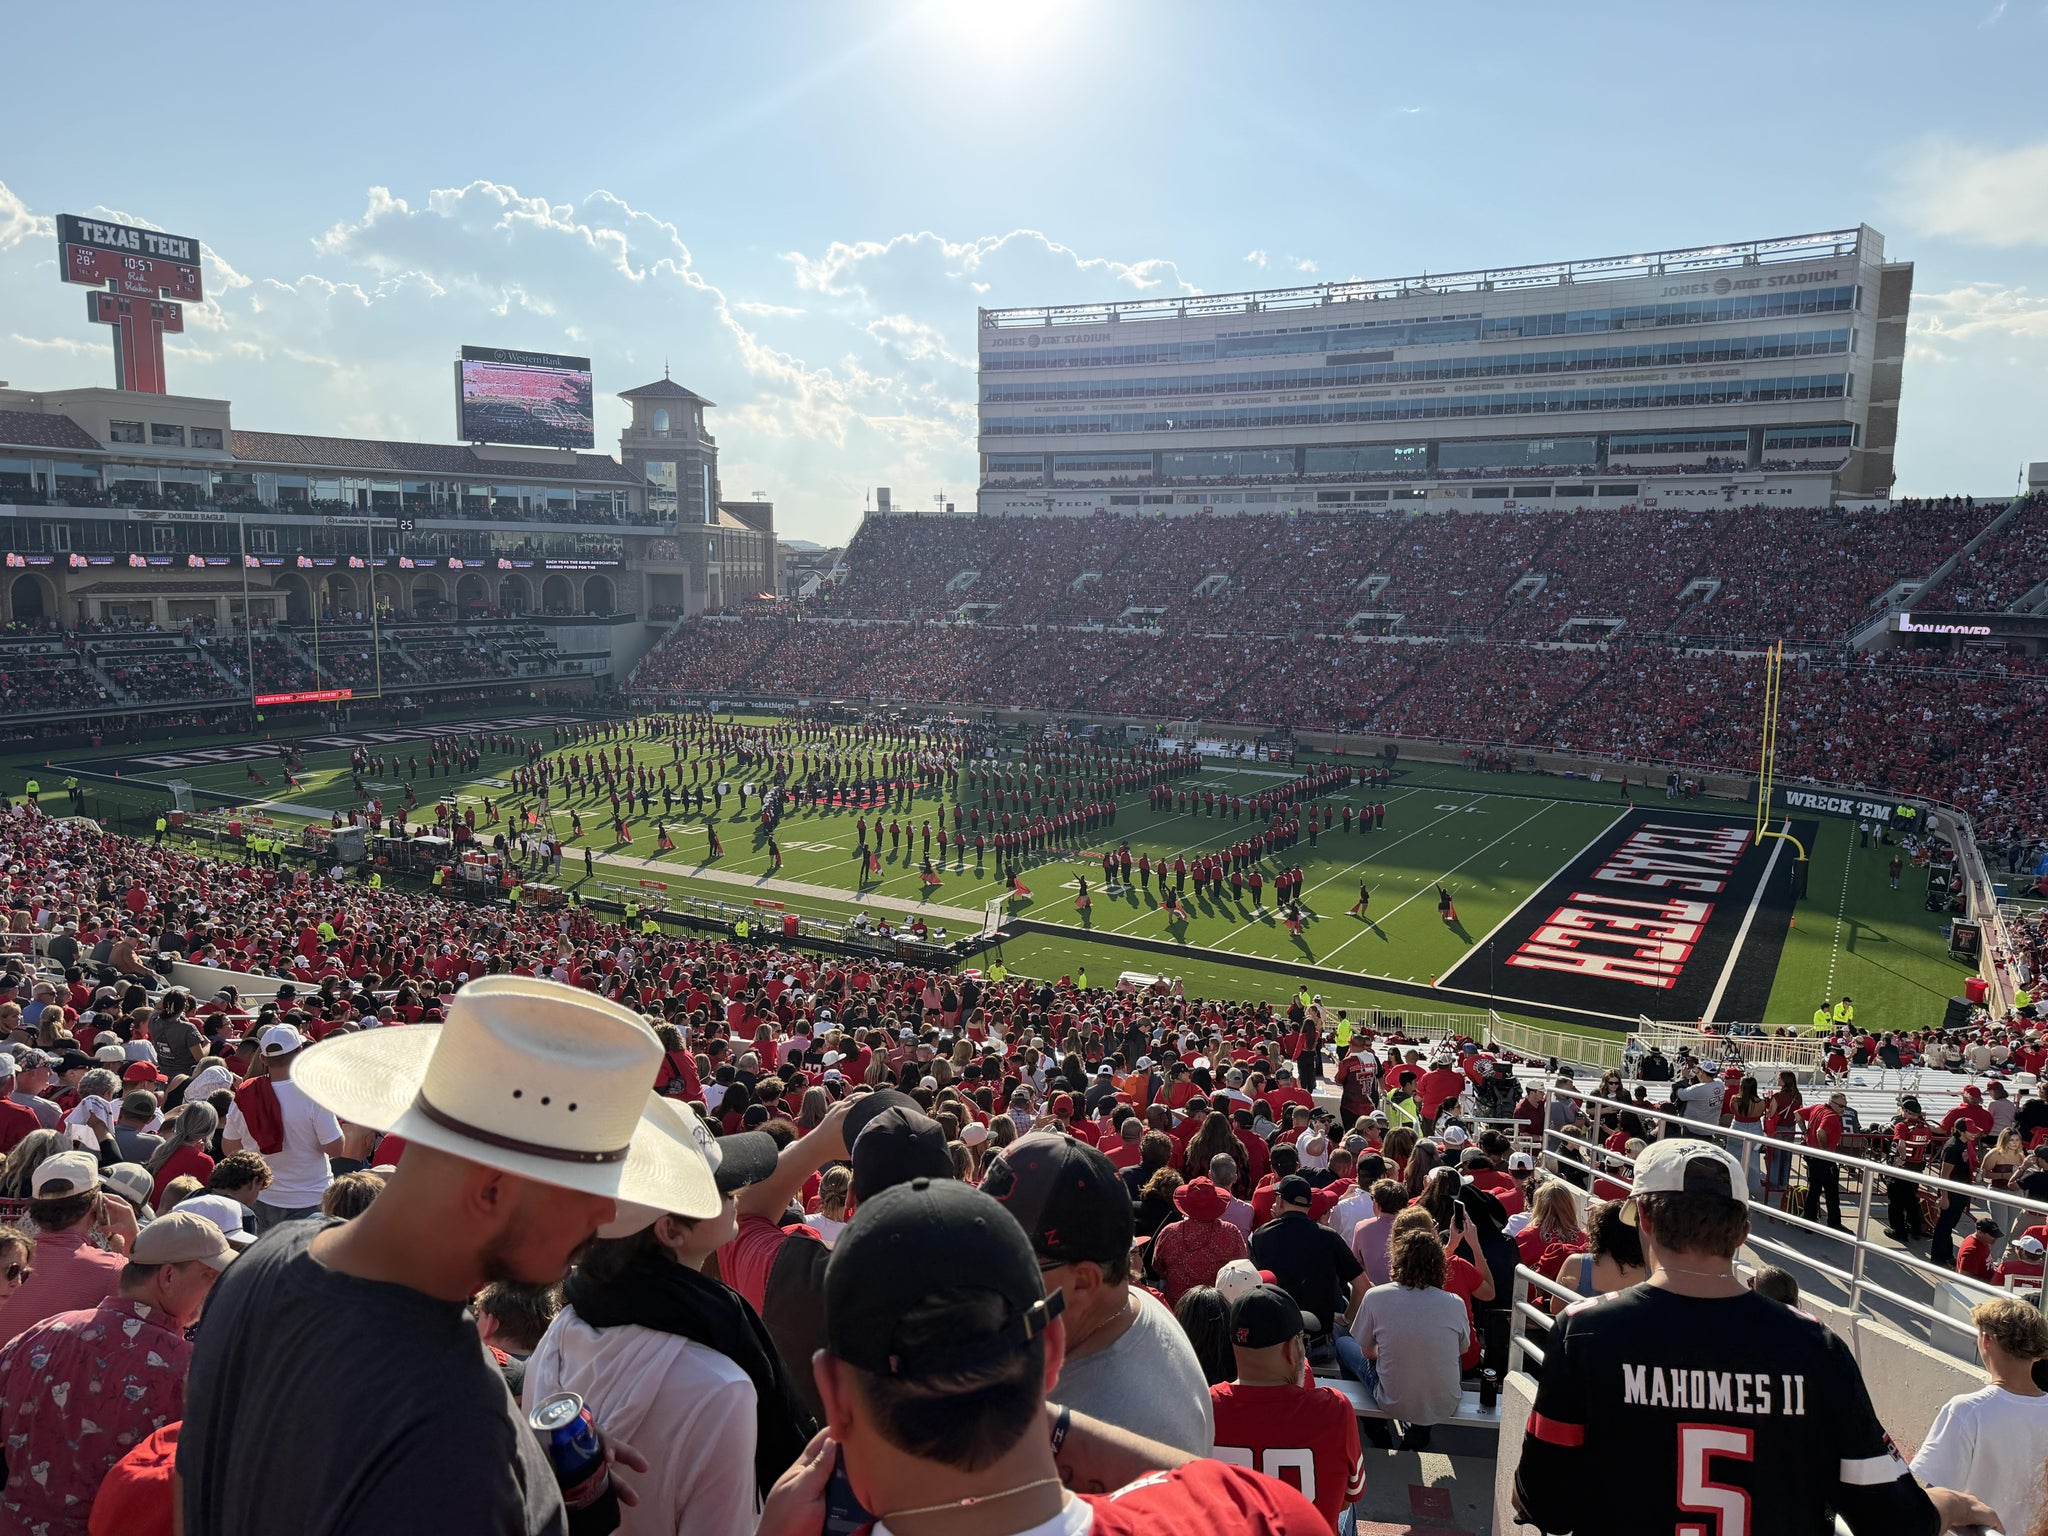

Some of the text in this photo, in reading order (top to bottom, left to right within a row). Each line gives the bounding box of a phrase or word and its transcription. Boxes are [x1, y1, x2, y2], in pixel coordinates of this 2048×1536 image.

[78, 221, 190, 260] TEXAS TECH
[76, 254, 90, 266] 28
[124, 257, 153, 272] 10:57
[188, 274, 195, 284] 0
[1661, 269, 1838, 298] JONES AT&T STADIUM
[171, 310, 176, 319] 2
[991, 333, 1110, 347] JONES AT&T STADIUM
[508, 352, 562, 366] Western Bank
[1739, 488, 1793, 496] TECH
[168, 512, 225, 521] DOUBLE EAGLE
[400, 520, 413, 530] 25
[1786, 790, 1852, 815] WRECK
[1589, 823, 1755, 894] TEXAS
[1504, 891, 1715, 989] TECH
[1622, 1363, 1806, 1416] MAHOMES II
[1677, 1422, 1755, 1536] 5
